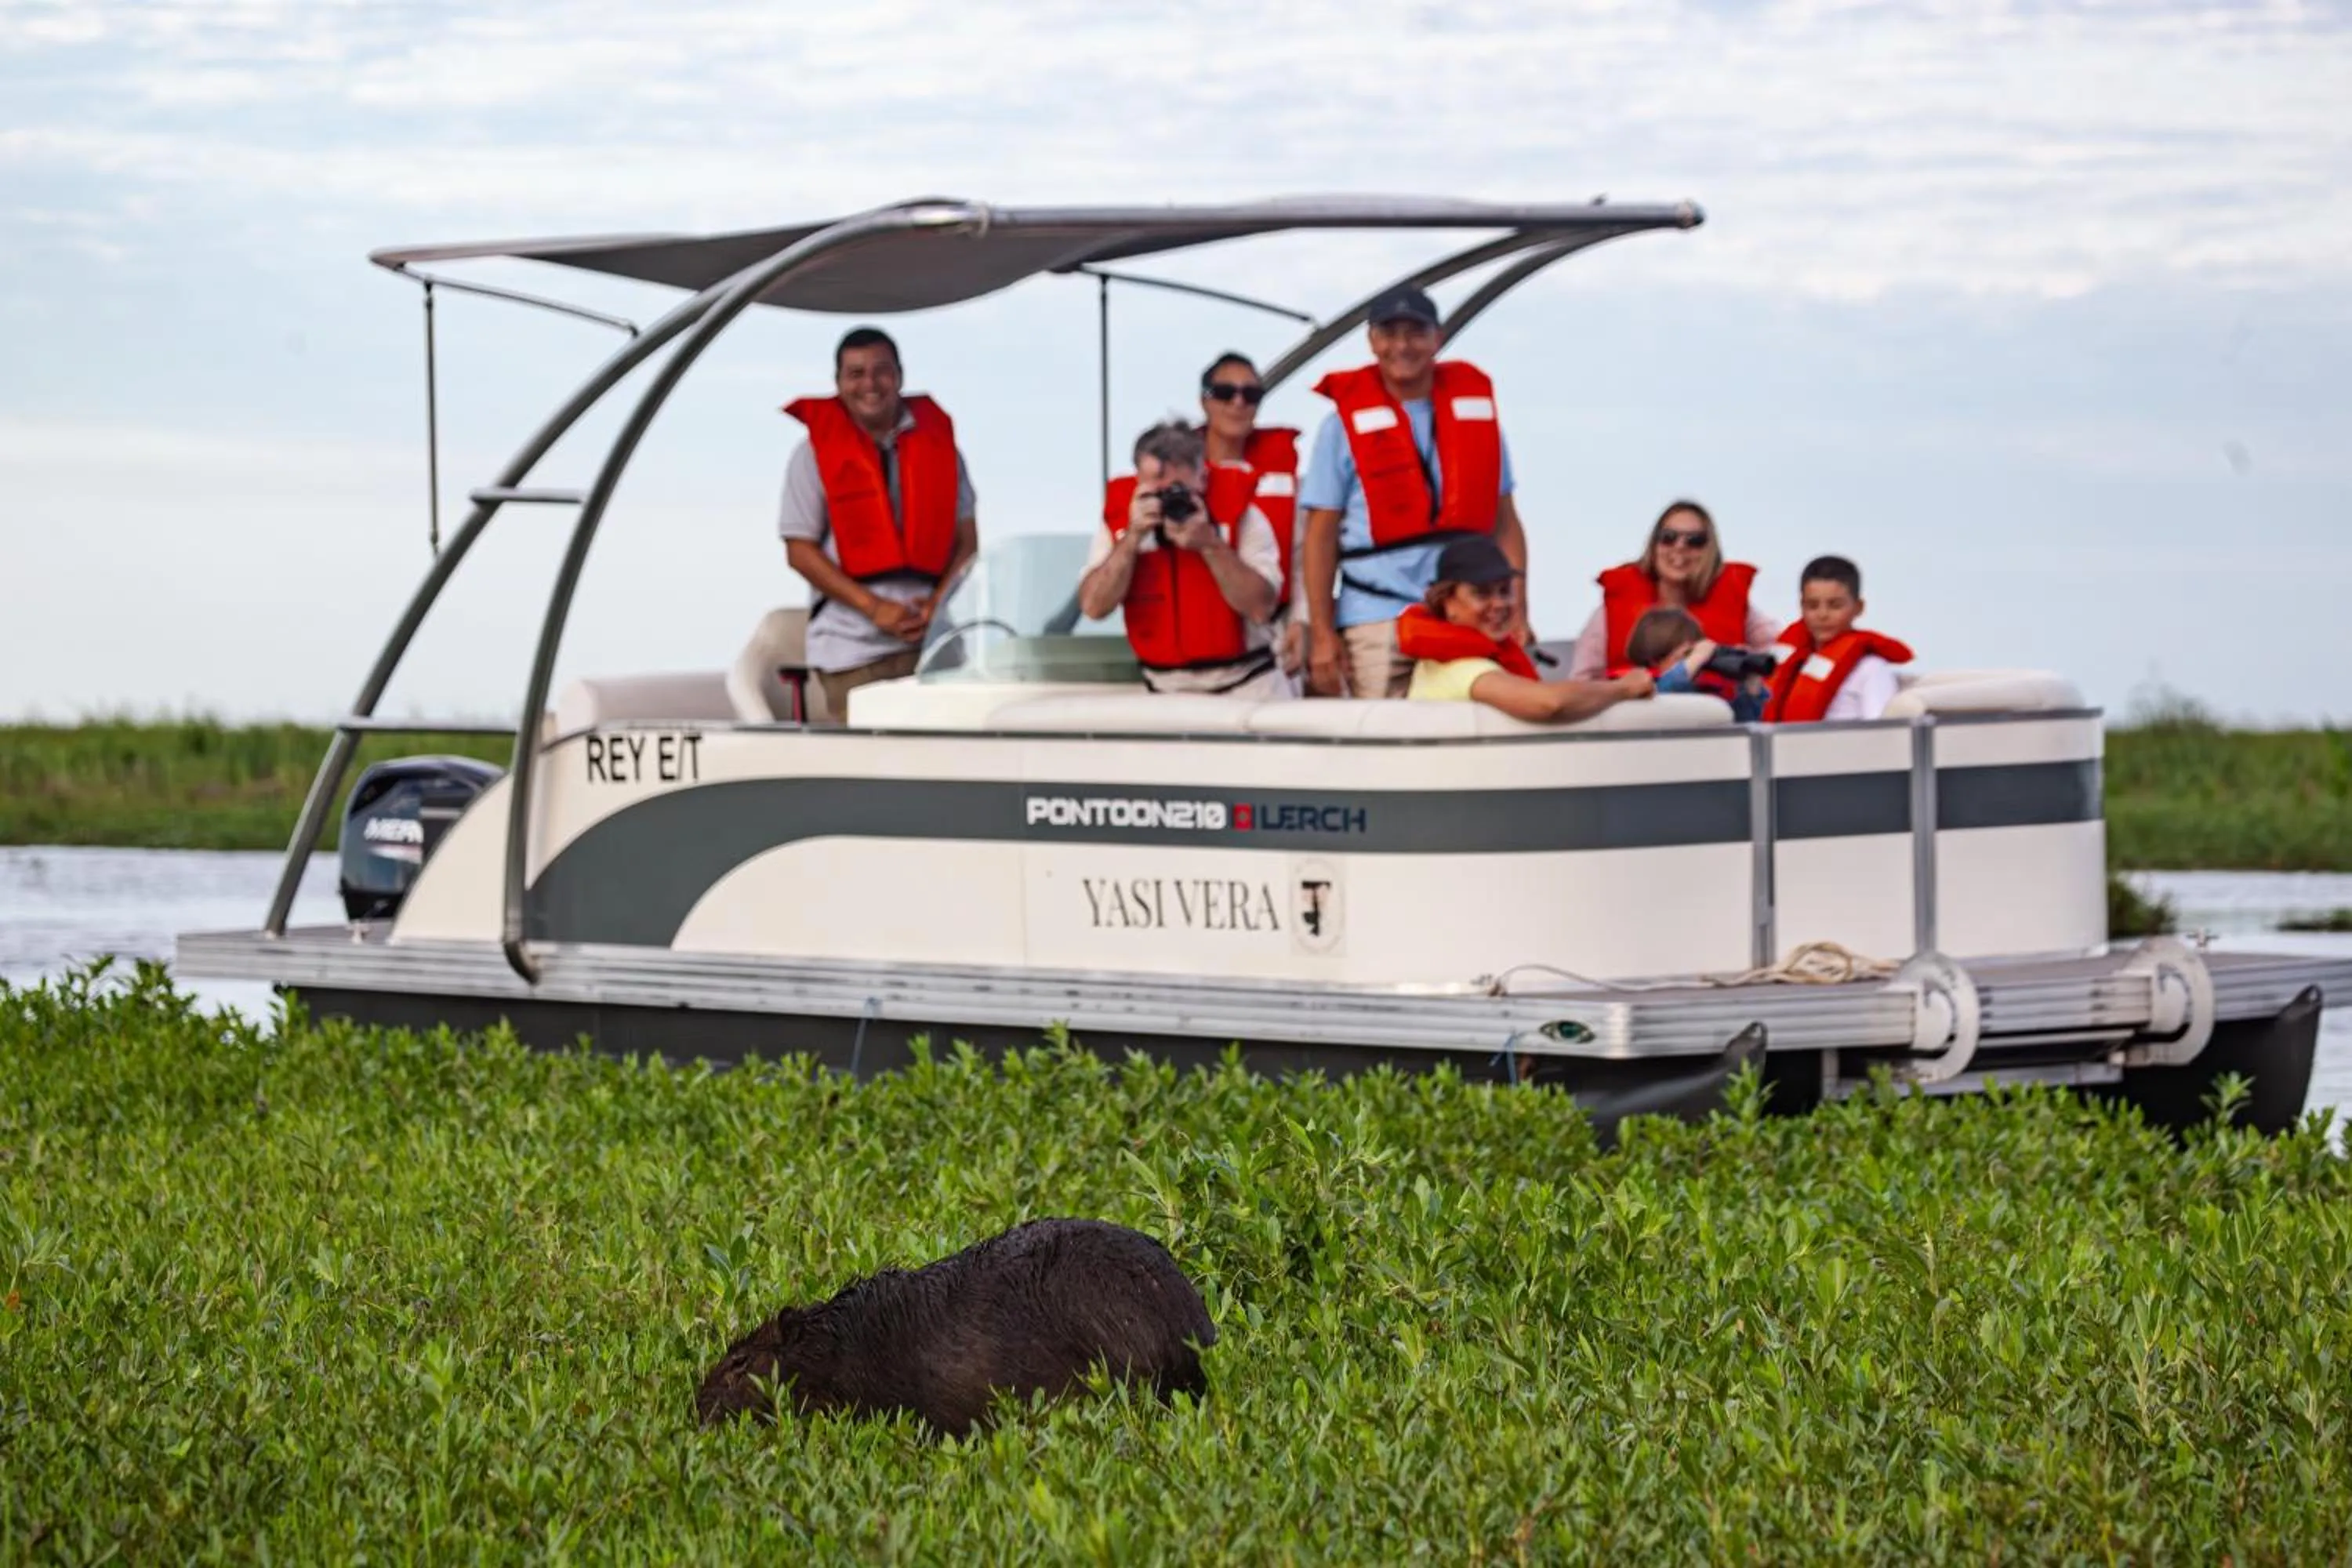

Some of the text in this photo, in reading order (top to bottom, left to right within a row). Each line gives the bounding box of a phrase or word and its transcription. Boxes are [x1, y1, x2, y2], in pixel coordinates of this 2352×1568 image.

[587, 735, 646, 782] REY
[1026, 797, 1367, 833] PONTOON210 LERCH
[1083, 878, 1280, 931] YASI VERA
